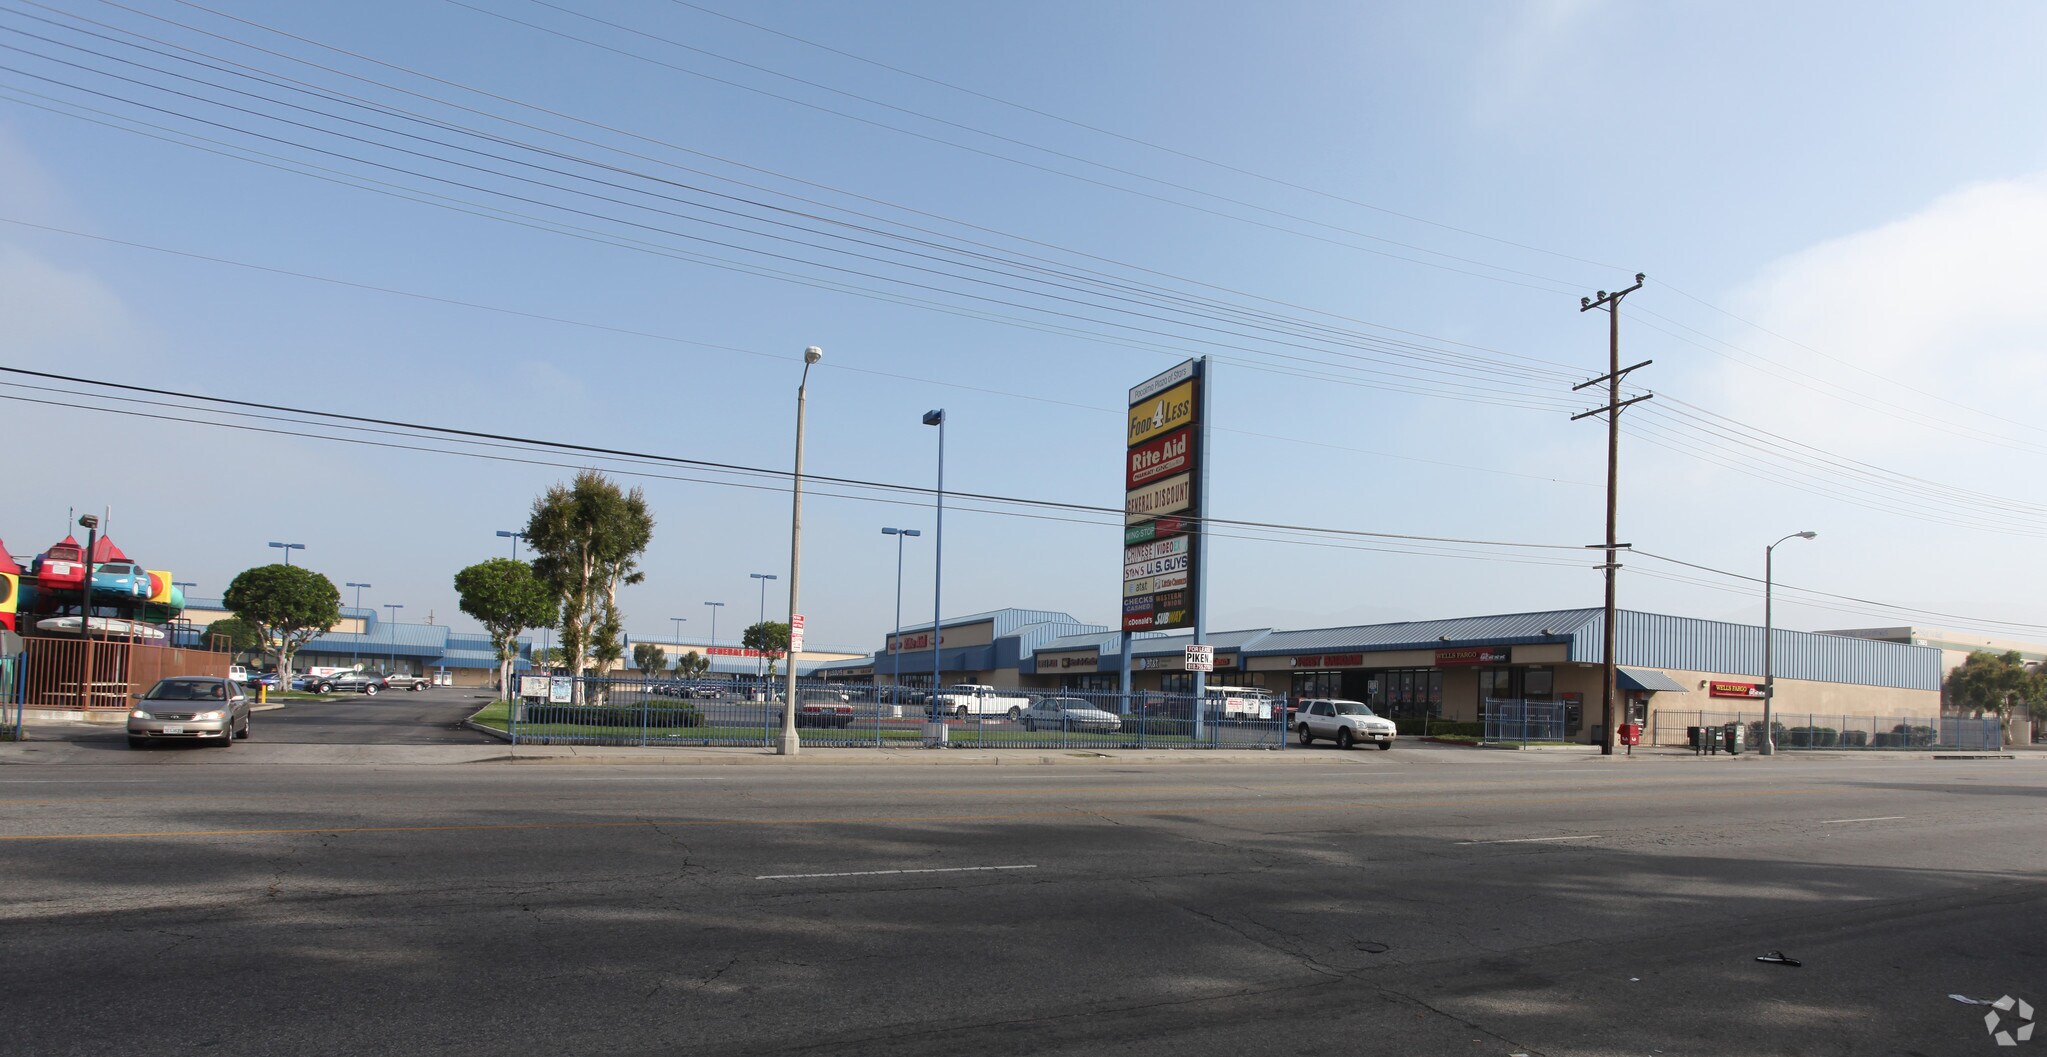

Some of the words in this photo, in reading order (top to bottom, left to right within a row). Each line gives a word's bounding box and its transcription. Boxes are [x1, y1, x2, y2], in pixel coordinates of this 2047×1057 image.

[1154, 375, 1168, 390] Plaza
[1174, 368, 1187, 380] Stars
[1152, 399, 1164, 430] 4
[1132, 450, 1160, 472] Rite
[1162, 434, 1186, 460] Aid
[1128, 493, 1152, 516] GENERAL
[1155, 481, 1188, 508] DISCOUNT
[1127, 542, 1152, 560] CHINESE
[1164, 556, 1188, 571] GUYS
[1124, 596, 1154, 606] CHECKS
[1155, 610, 1184, 625] SUBWAY
[707, 647, 742, 656] GENERAL
